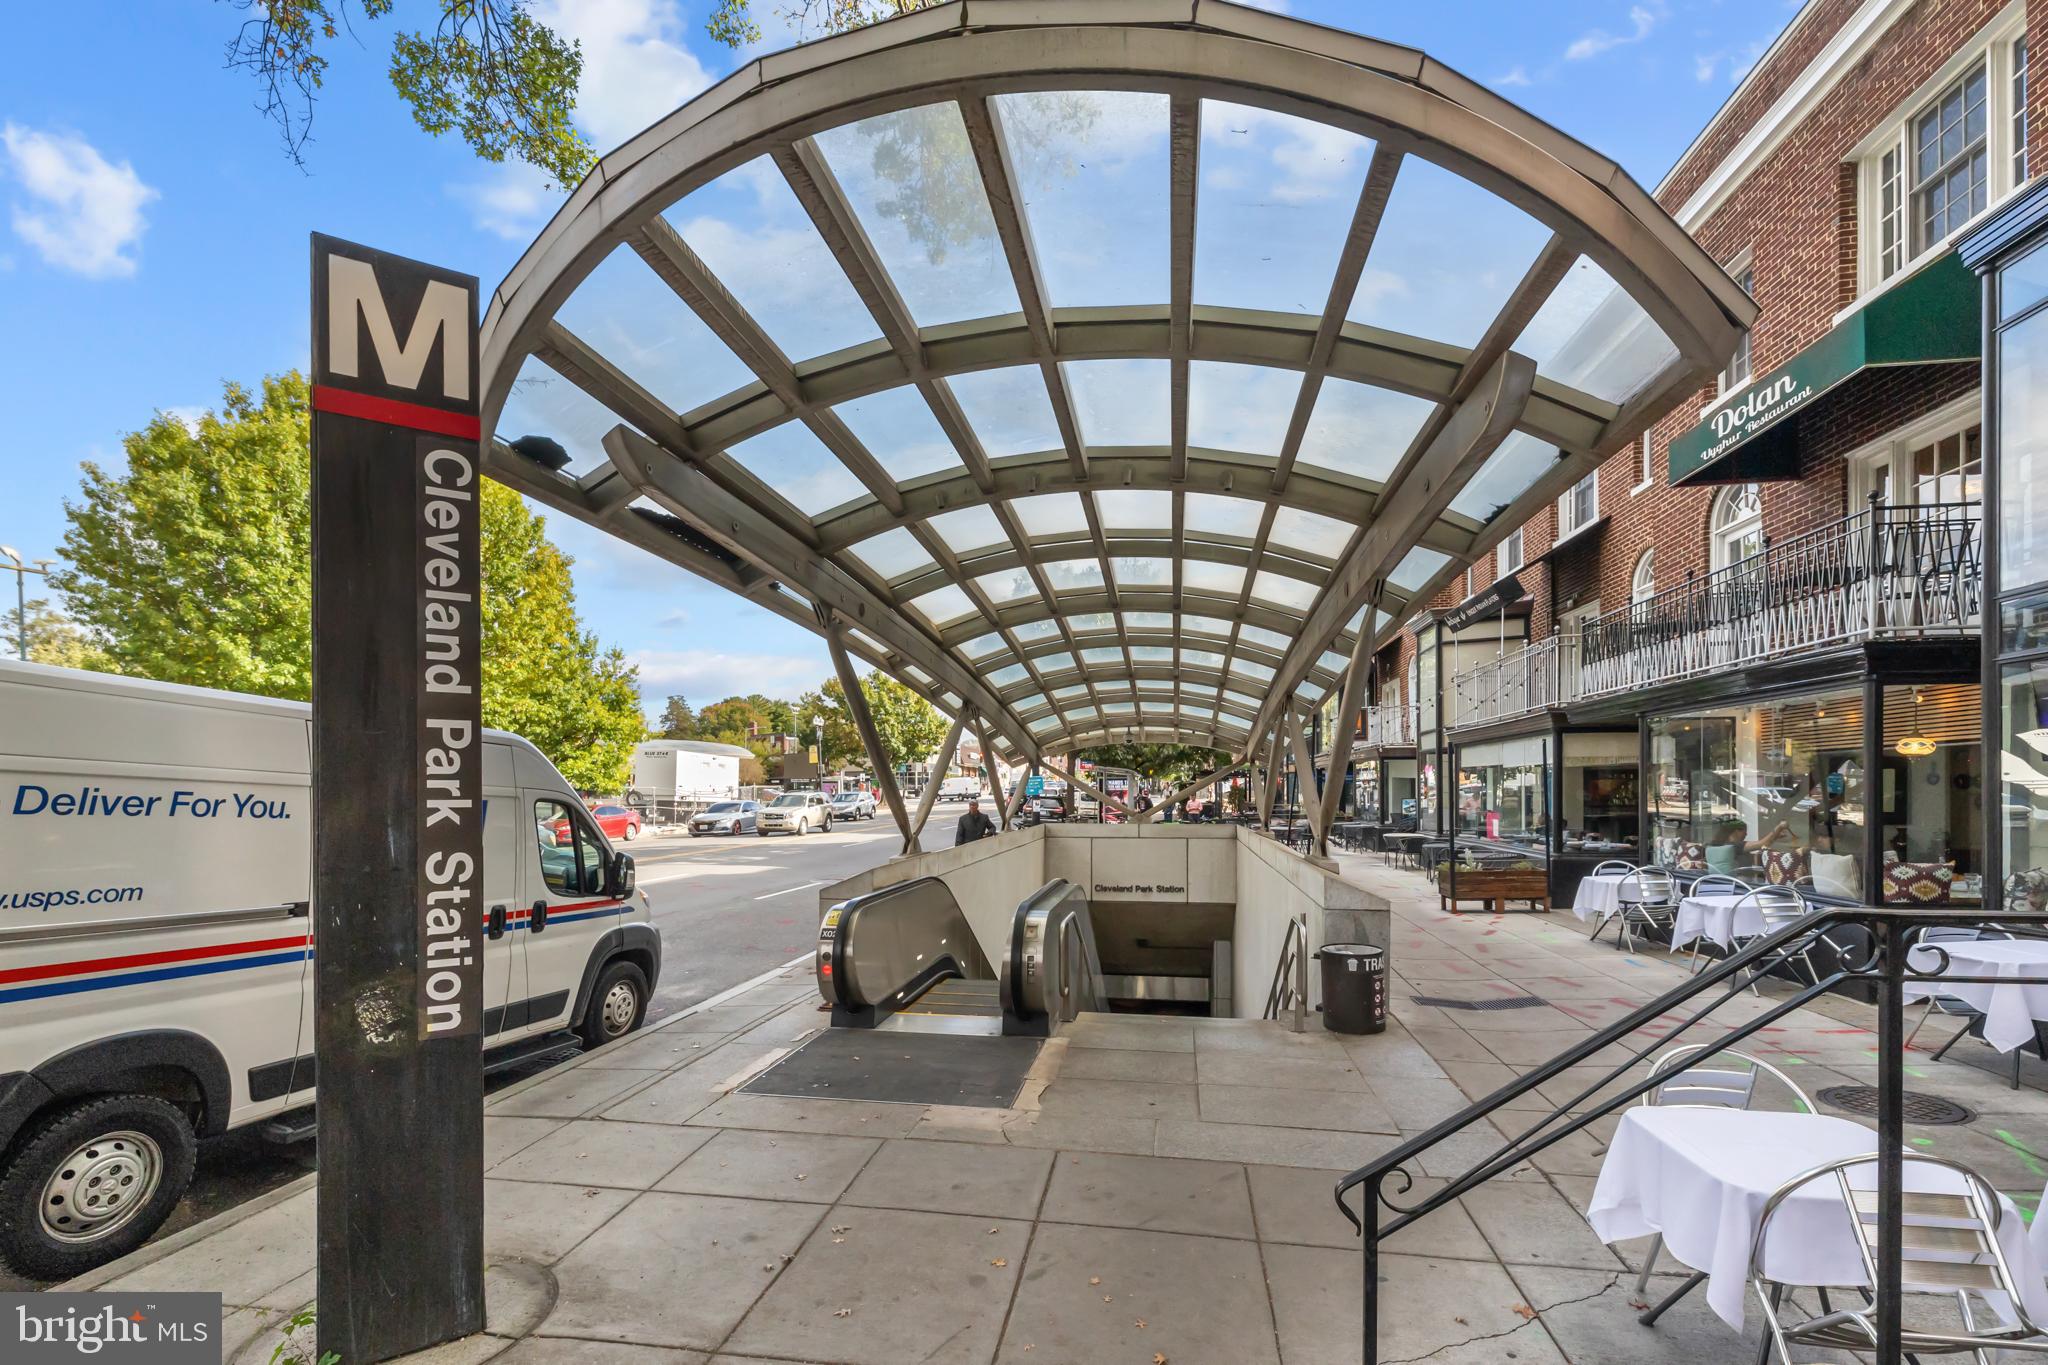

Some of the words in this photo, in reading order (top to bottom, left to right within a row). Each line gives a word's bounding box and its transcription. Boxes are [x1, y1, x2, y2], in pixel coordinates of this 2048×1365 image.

[328, 252, 470, 401] M
[1700, 431, 1742, 460] Uyghur
[1744, 385, 1813, 433] Restaurant
[1711, 375, 1797, 438] Dolan
[423, 449, 473, 694] Cleveland
[12, 784, 162, 817] Deliver
[168, 790, 227, 818] For
[232, 793, 291, 819] You.
[425, 718, 473, 828] Park
[1094, 884, 1133, 893] Cleveland
[1135, 884, 1153, 893] Park
[1156, 884, 1185, 893] Station
[424, 851, 474, 1033] Station
